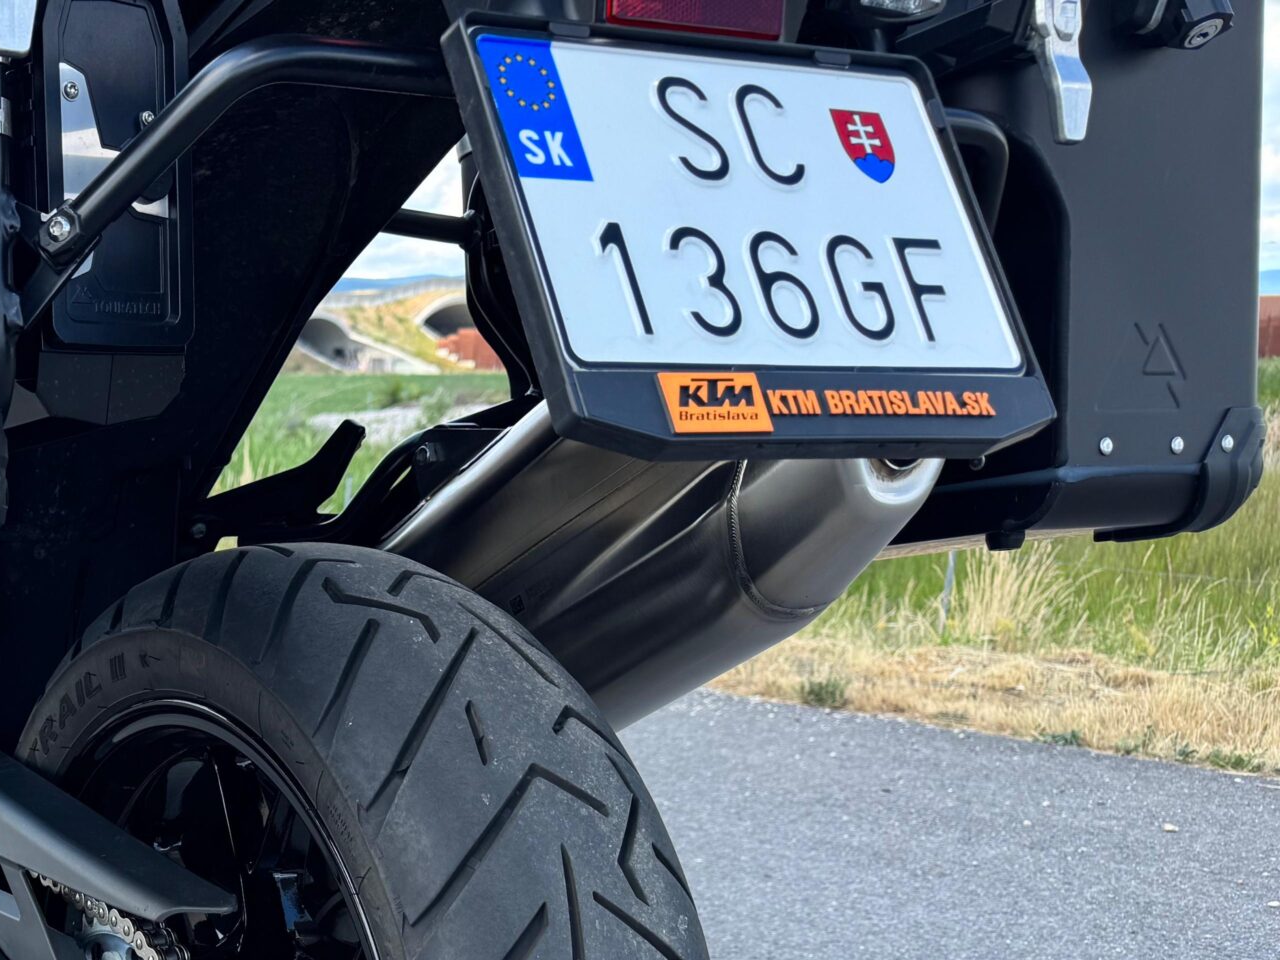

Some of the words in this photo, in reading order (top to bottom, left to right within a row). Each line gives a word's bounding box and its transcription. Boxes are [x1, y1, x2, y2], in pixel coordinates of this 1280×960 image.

[656, 75, 806, 186] SC
[518, 129, 574, 167] SK
[598, 221, 947, 343] 136GF
[678, 378, 755, 408] KTM
[767, 389, 821, 416] KTM
[824, 389, 997, 417] BRATISLAVA.SK
[678, 410, 760, 422] Bratislava
